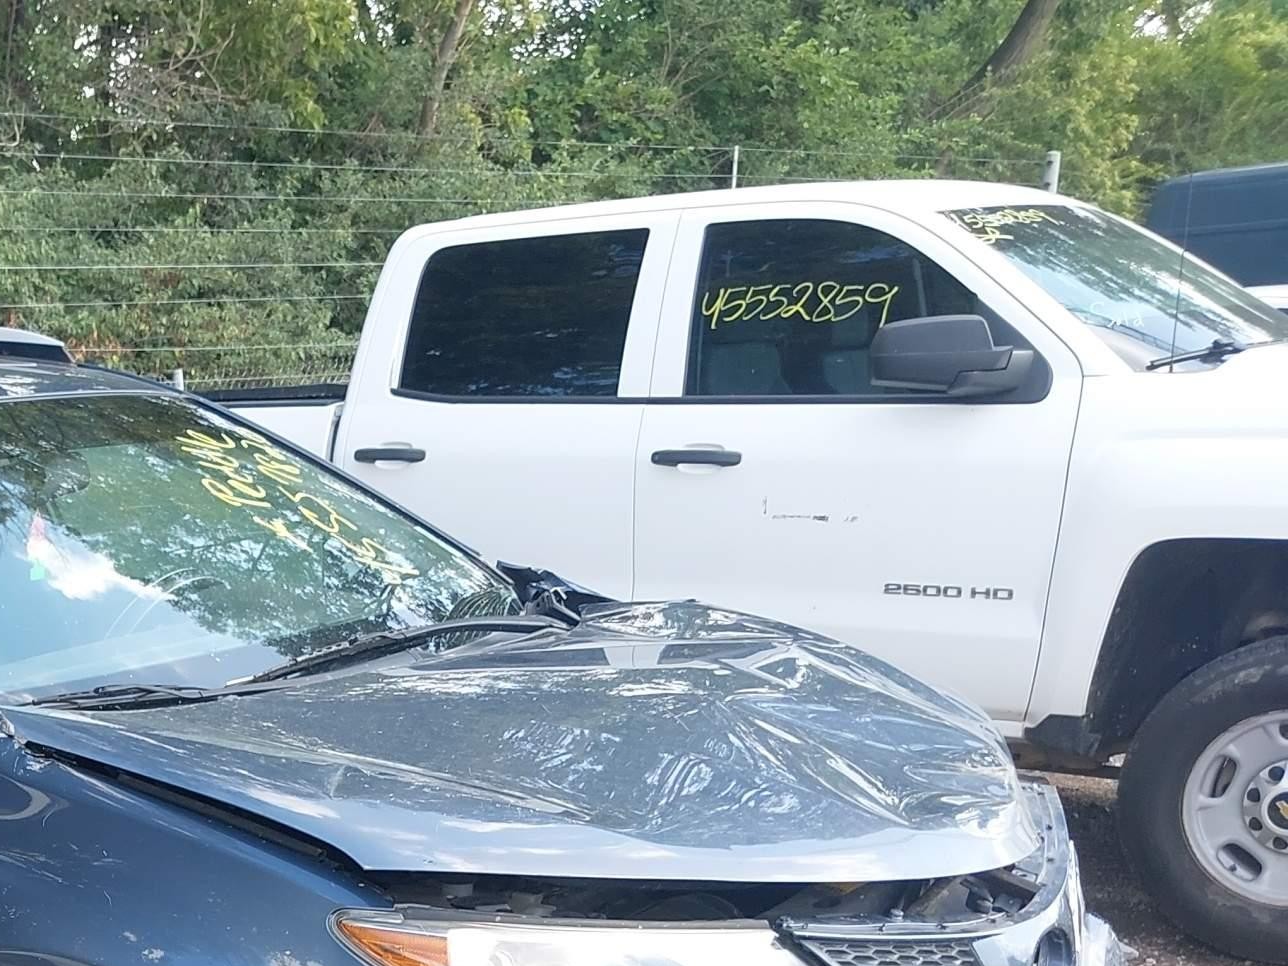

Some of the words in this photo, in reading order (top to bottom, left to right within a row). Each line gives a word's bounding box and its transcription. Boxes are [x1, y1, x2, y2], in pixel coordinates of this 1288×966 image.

[702, 281, 899, 329] 45552859
[883, 583, 962, 598] 2500
[970, 587, 1014, 600] HD
